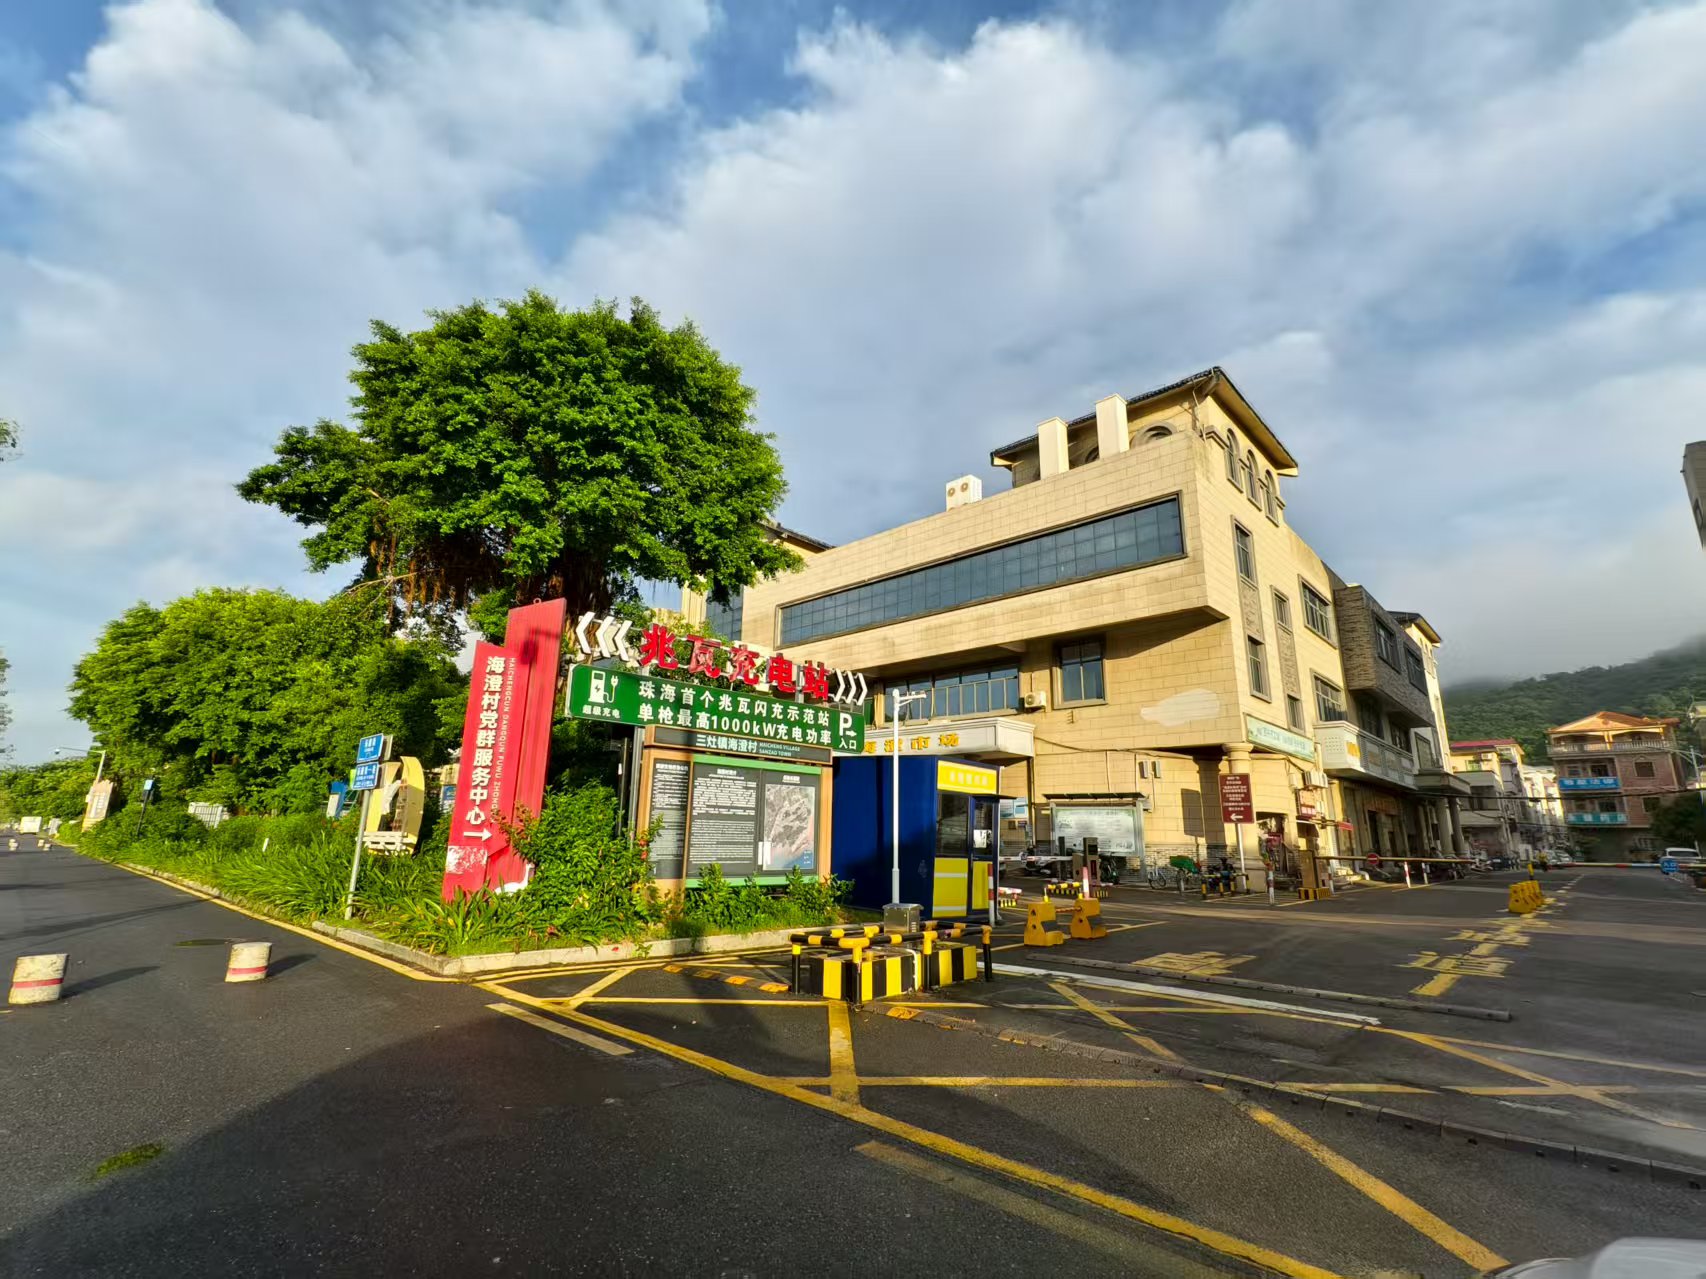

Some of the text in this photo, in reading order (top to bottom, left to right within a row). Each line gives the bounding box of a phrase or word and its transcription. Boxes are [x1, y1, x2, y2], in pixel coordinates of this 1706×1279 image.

[640, 623, 829, 702] 兆瓦充电站
[503, 657, 516, 712] HAICHENGCUN
[638, 680, 830, 727] 珠海首个兆瓦闪充示范站
[465, 656, 506, 825] 海澄村党群服务中心
[637, 702, 832, 745] 单枪最高1000kW充电功率
[695, 733, 758, 753] 三灶镇海澄村
[838, 738, 857, 750] 入口
[839, 712, 853, 737] P
[494, 755, 505, 779] FUWU
